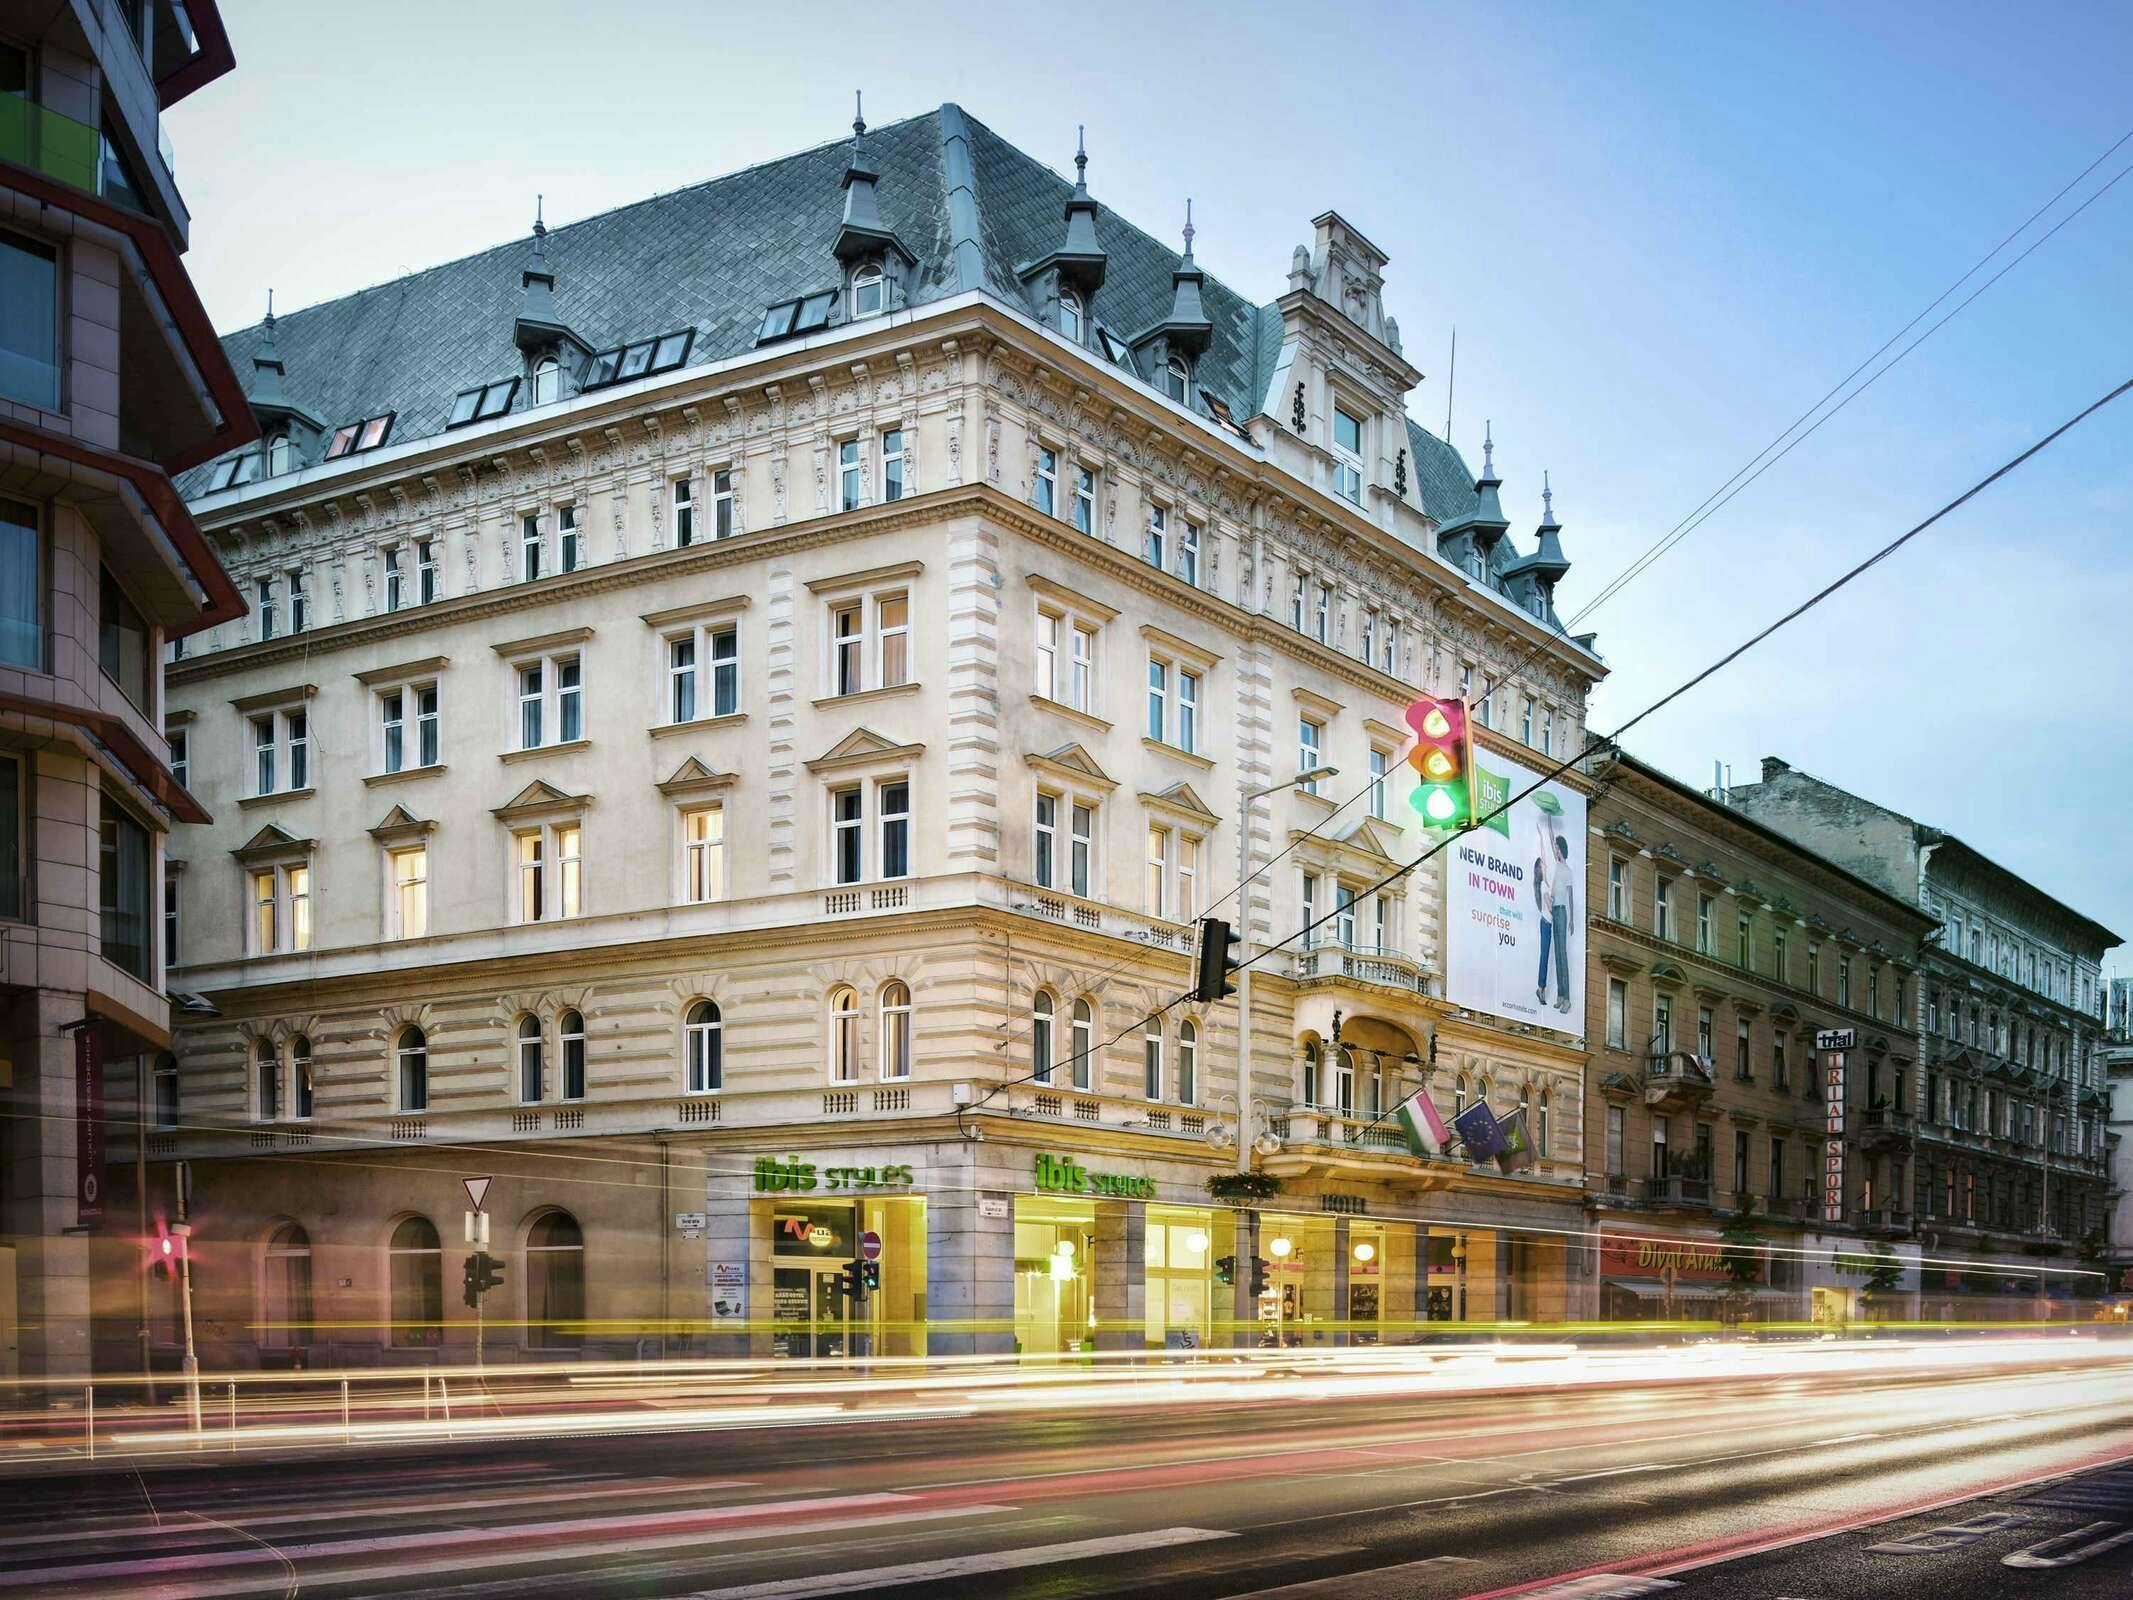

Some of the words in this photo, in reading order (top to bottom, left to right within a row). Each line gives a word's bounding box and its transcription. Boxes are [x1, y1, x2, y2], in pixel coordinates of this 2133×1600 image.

[1483, 780, 1502, 804] ibis
[1459, 846, 1485, 868] NEW
[1488, 856, 1523, 881] BRAND
[1468, 872, 1480, 889] IN
[1482, 877, 1515, 901] TOWN
[1471, 909, 1511, 931] surprise
[1498, 932, 1516, 946] you
[1818, 1031, 1851, 1048] trial
[1828, 1053, 1841, 1132] TRIAL
[755, 1155, 817, 1191] ibis
[1035, 1153, 1088, 1192] ibis
[1826, 1142, 1840, 1219] SPORT
